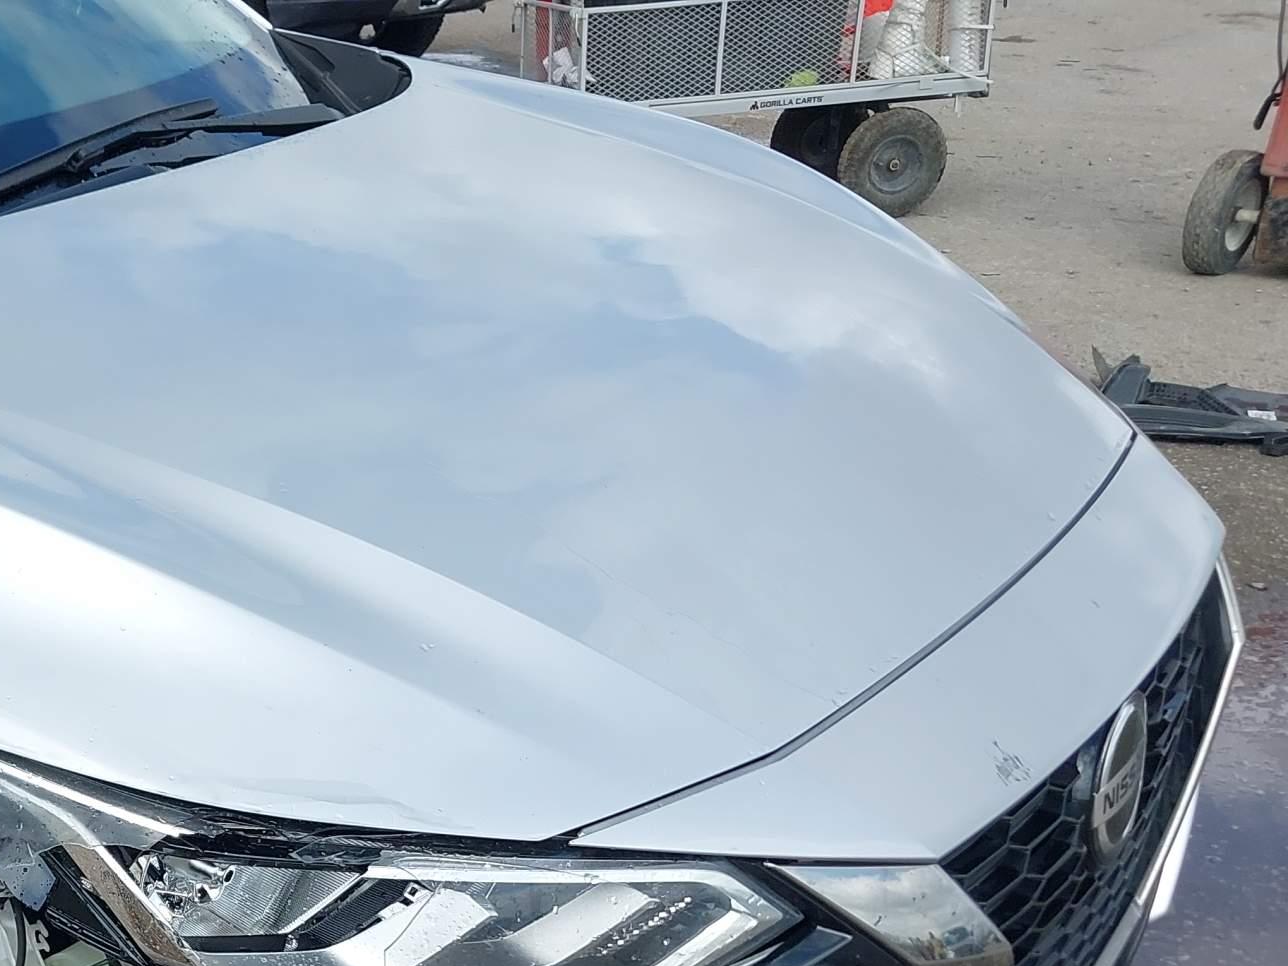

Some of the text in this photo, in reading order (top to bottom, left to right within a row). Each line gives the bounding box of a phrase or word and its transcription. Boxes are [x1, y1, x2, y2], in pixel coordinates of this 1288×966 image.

[759, 96, 823, 109] GORILLA CARTS
[1103, 758, 1139, 815] NISS
